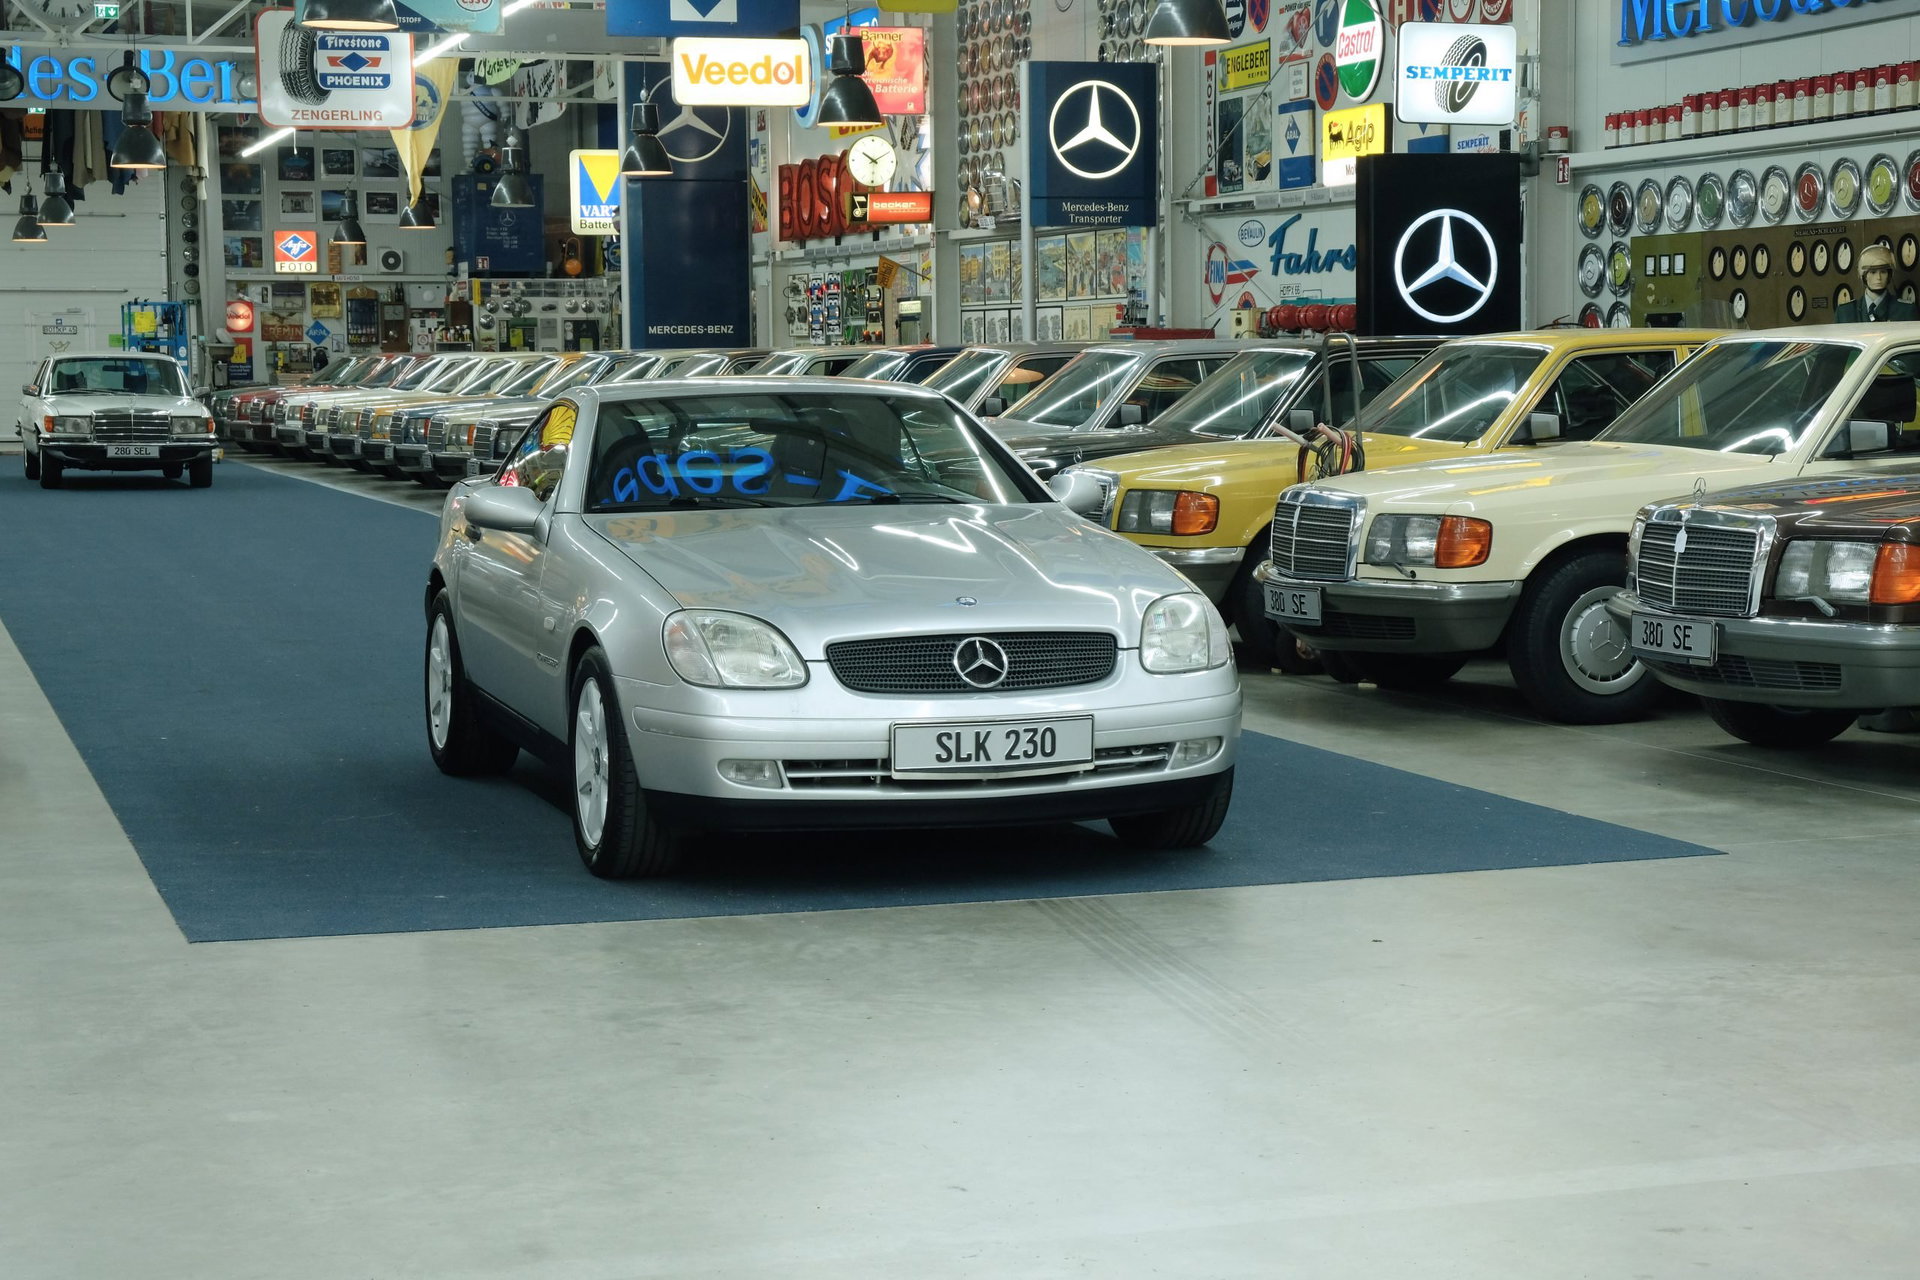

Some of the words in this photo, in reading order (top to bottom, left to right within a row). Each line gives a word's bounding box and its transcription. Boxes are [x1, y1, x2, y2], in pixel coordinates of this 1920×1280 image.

[325, 35, 382, 49] Firestone
[861, 30, 903, 41] Banner
[1337, 26, 1376, 59] Castrol
[1226, 49, 1270, 74] ENGLEBERT
[681, 53, 803, 85] Veedol
[1406, 65, 1512, 82] SEMPERIT
[326, 75, 384, 87] PHOENIX
[875, 84, 918, 93] Batterie
[291, 109, 383, 121] ZENGERLING
[1286, 130, 1299, 140] ARAL
[1346, 117, 1375, 152] Agip
[1457, 136, 1490, 151] SEMPERIT
[1345, 164, 1356, 176] Mo
[1062, 202, 1129, 212] Mercedes-Benz
[1069, 213, 1122, 225] Transporter
[279, 262, 313, 272] FOTO
[1209, 260, 1225, 284] FINA
[648, 325, 734, 335] MERCEDES-BENZ
[114, 447, 130, 456] 280
[134, 446, 151, 456] SEL
[1270, 590, 1285, 612] 380
[1292, 593, 1307, 615] SE
[1642, 620, 1663, 648] 380
[1672, 624, 1693, 651] SE
[935, 730, 992, 763] SLK
[1005, 726, 1057, 761] 230
